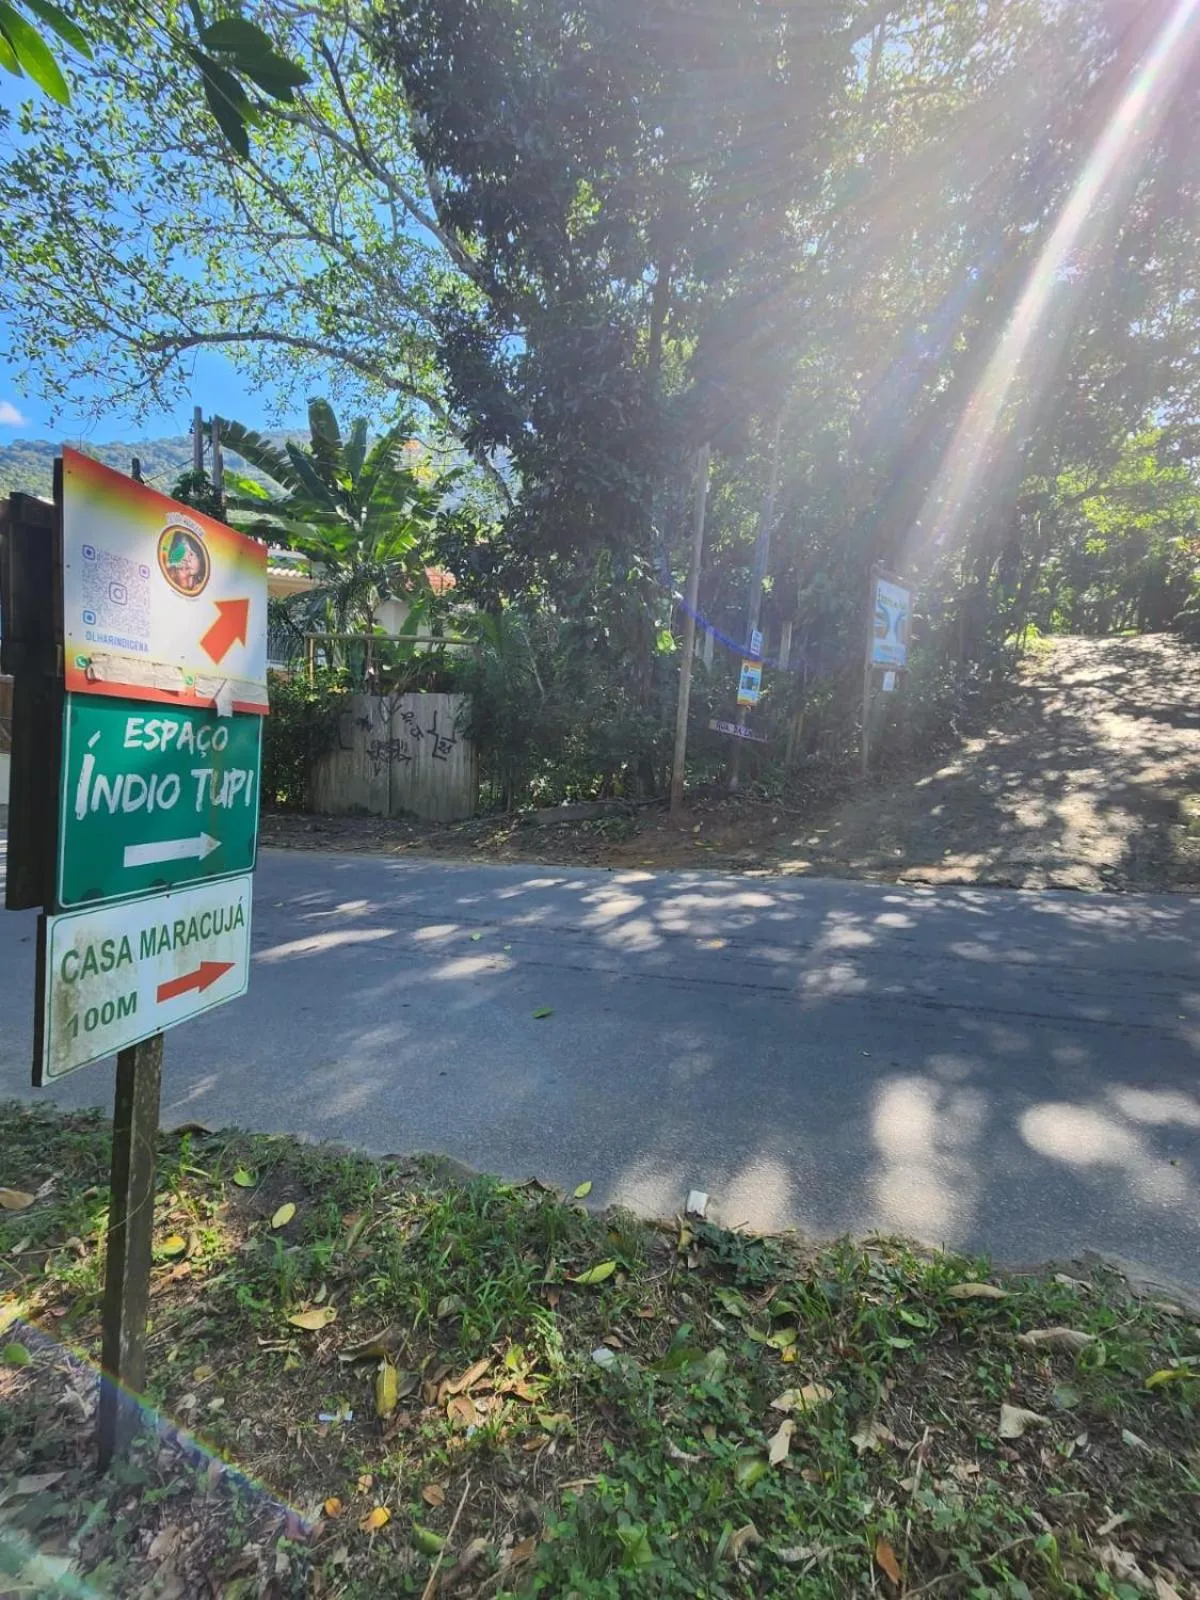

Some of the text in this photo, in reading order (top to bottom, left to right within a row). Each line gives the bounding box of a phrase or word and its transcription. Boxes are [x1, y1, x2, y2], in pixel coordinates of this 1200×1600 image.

[123, 717, 228, 758] ESPAÇO
[74, 730, 254, 820] ÍNDIO TUPI
[60, 896, 245, 984] CASA MARACUJÁ
[66, 991, 138, 1038] 100M
